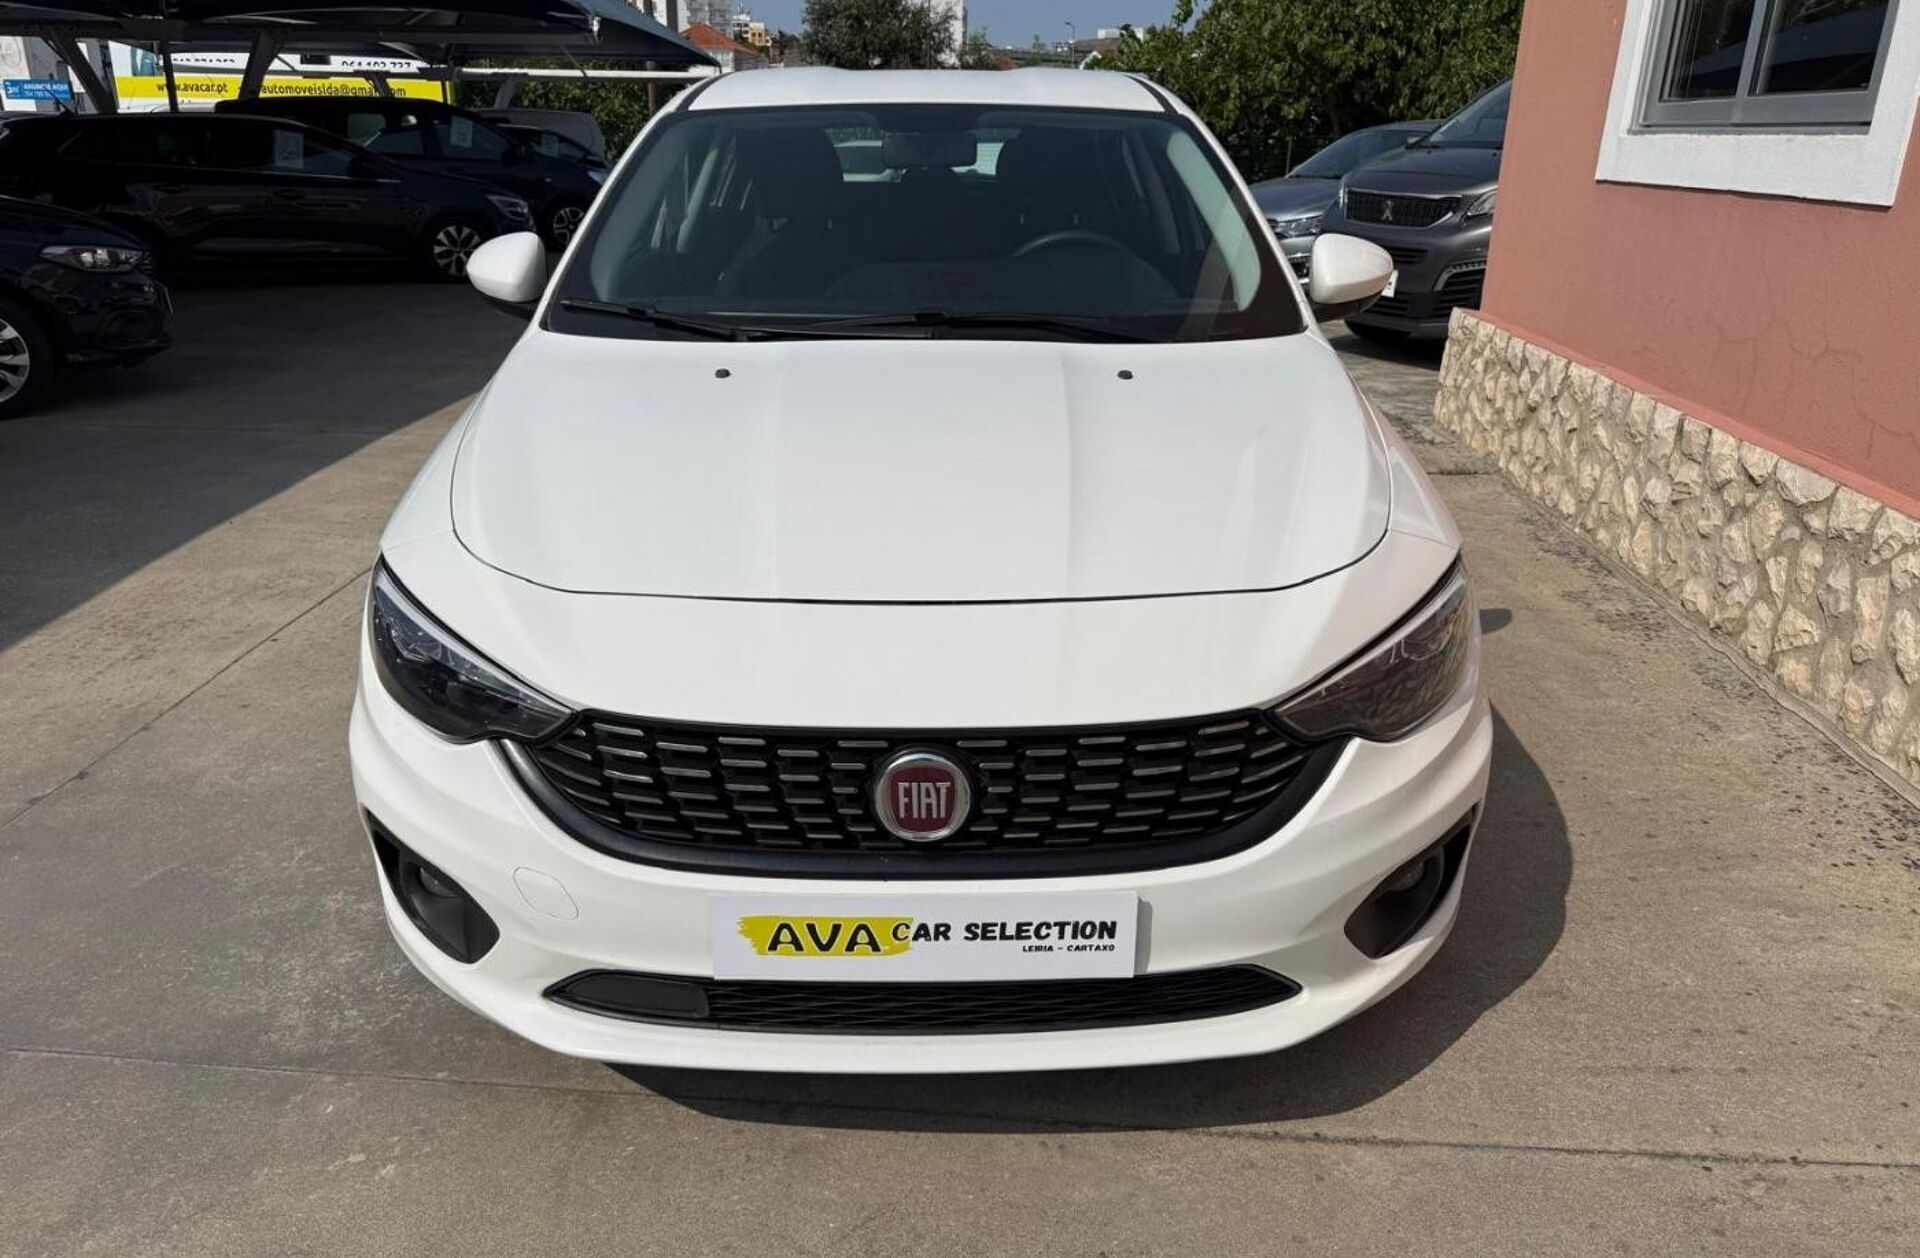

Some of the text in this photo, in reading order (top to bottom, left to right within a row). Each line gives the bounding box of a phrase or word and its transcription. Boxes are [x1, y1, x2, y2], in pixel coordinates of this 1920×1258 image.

[156, 82, 228, 95] ww.avacar.pt
[898, 782, 951, 819] FIAT
[767, 920, 1117, 953] AVA CAR SELECTION
[1066, 943, 1116, 952] CARTAXO
